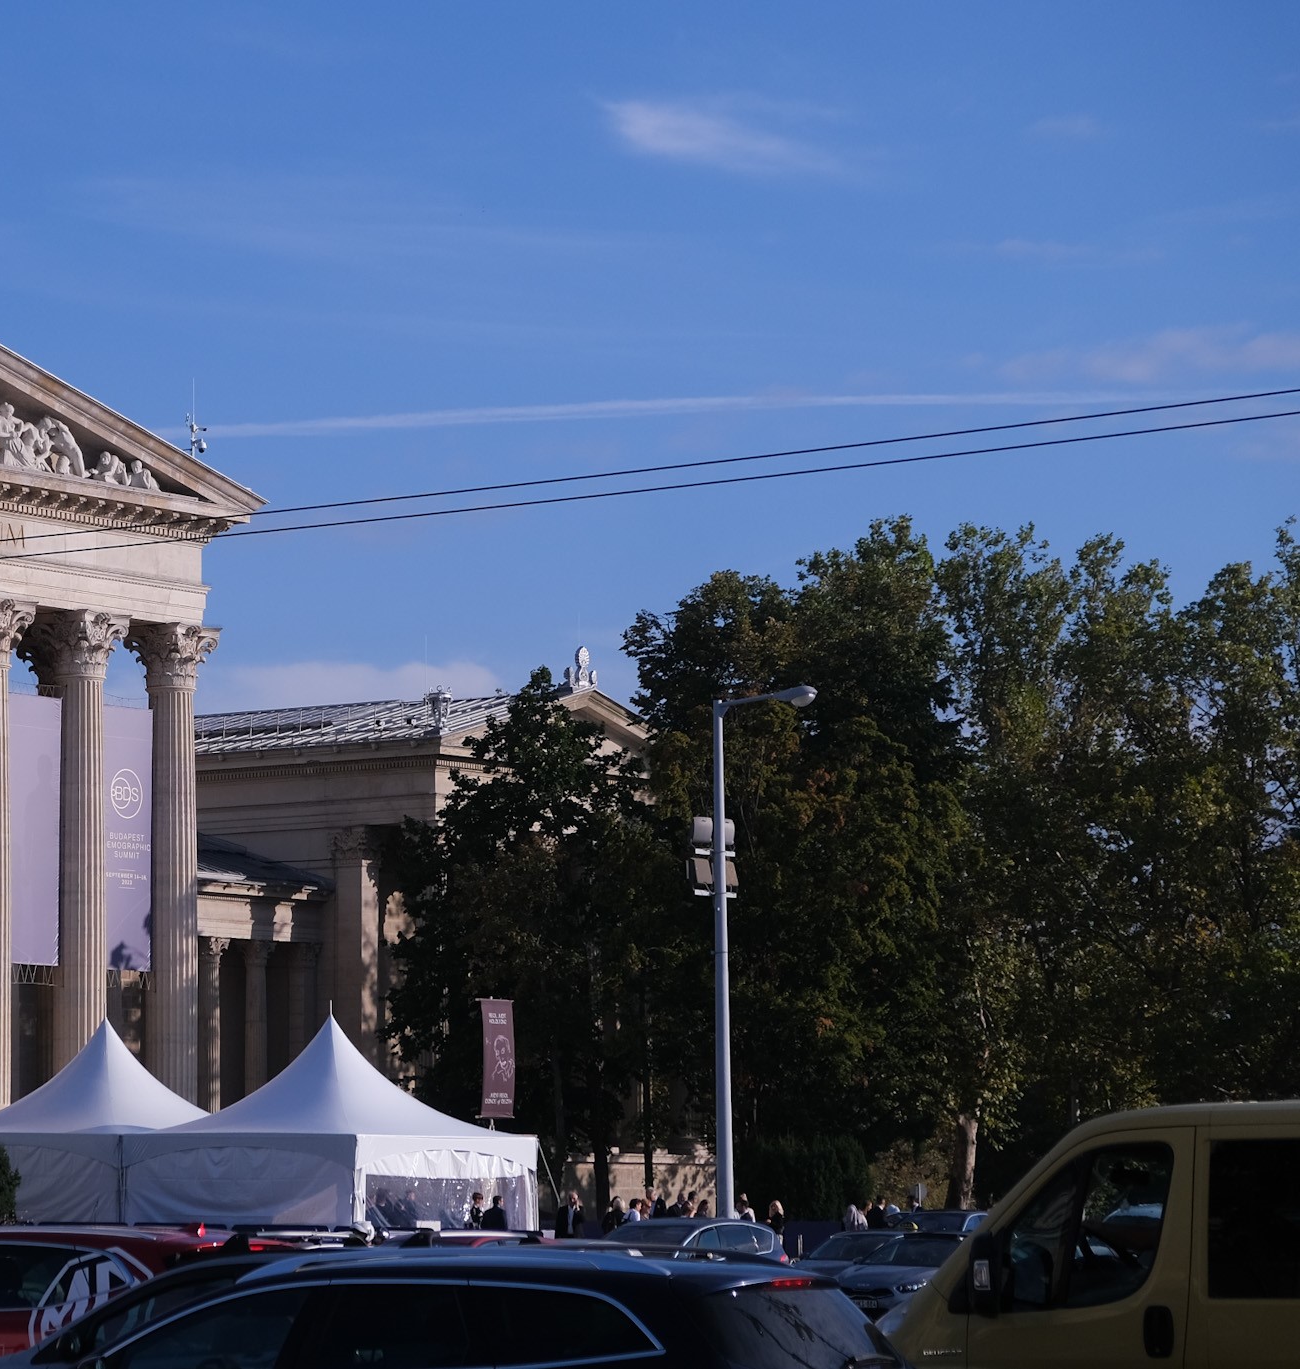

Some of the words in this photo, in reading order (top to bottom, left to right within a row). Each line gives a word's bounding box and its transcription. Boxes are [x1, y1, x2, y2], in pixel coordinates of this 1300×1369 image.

[115, 786, 139, 802] BDS
[109, 832, 145, 842] BUDAPEST
[106, 840, 151, 852] EMOGRAPHIC
[113, 850, 140, 859] SUMMIT
